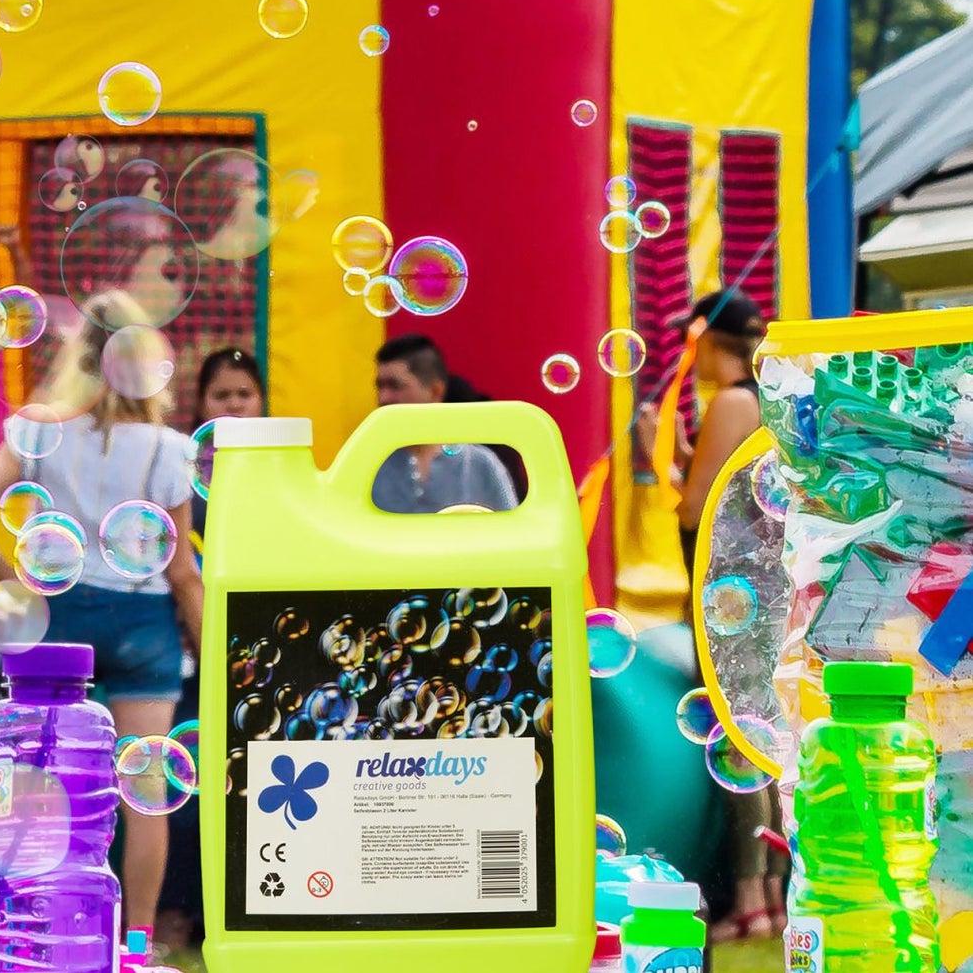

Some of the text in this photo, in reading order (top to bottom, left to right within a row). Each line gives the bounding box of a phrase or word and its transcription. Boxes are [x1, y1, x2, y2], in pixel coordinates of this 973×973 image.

[355, 750, 488, 786] relaxdays
[353, 780, 427, 793] creative goods
[259, 842, 286, 863] CE
